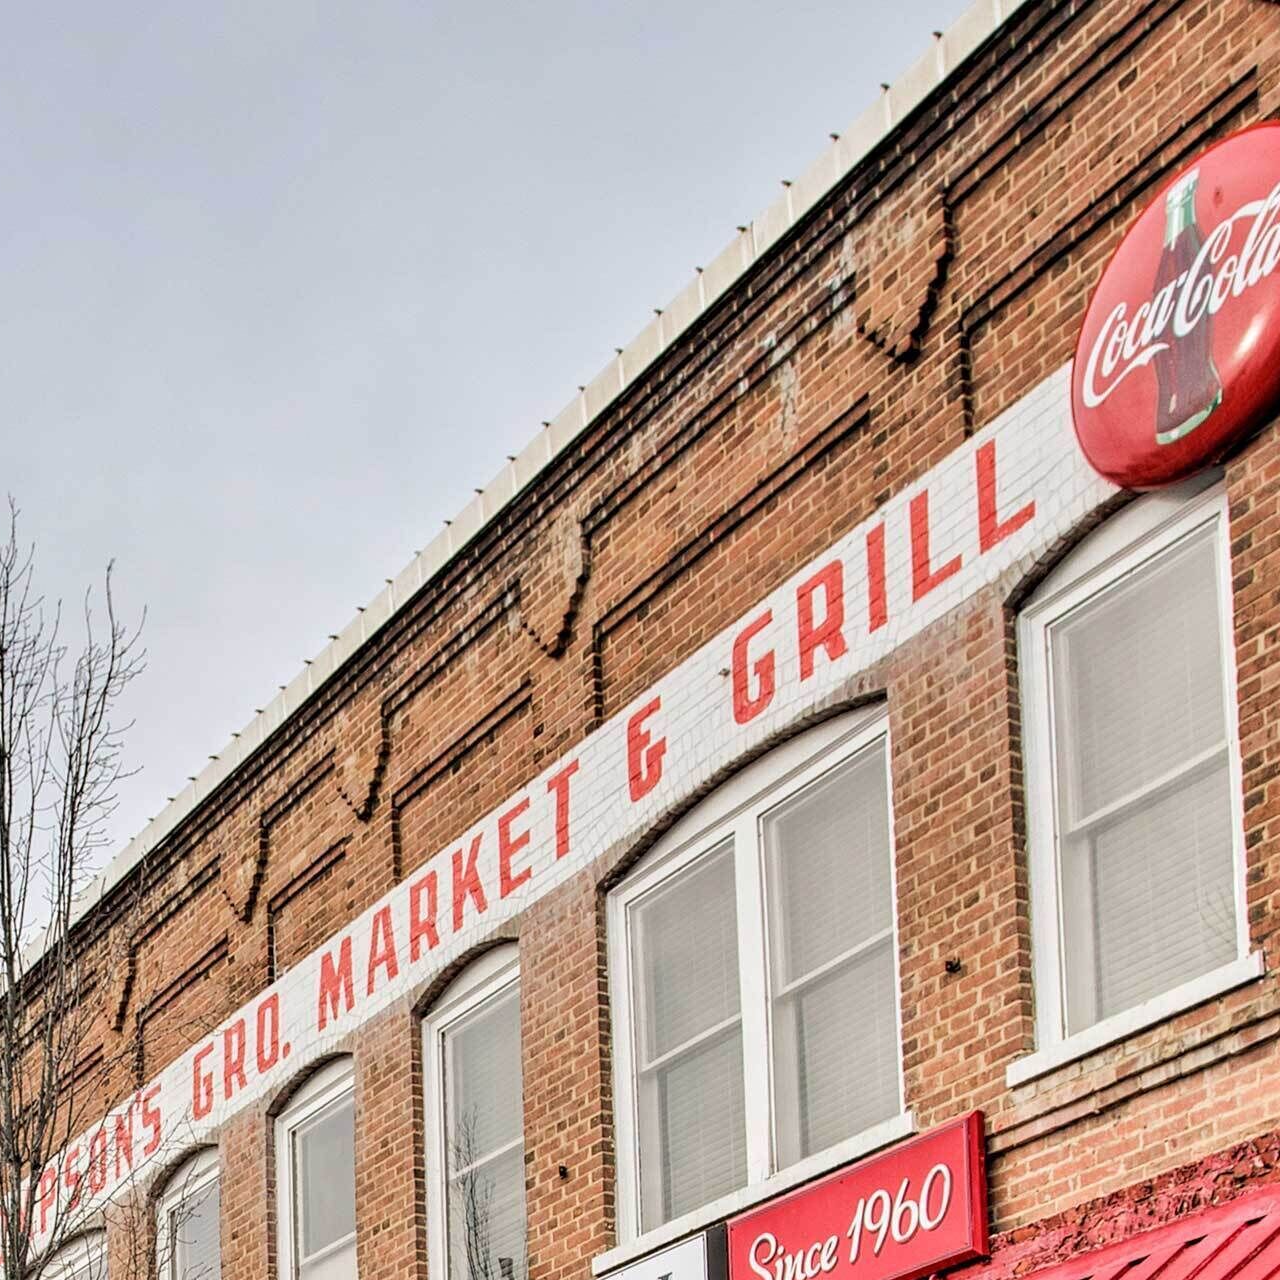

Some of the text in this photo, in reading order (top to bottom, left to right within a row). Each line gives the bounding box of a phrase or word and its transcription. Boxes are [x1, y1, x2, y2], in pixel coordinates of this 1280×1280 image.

[192, 996, 291, 1121] GRO.
[319, 759, 580, 1032] MARKET
[627, 695, 668, 803] &
[732, 438, 1036, 725] GRILL
[847, 1164, 952, 1264] 1960
